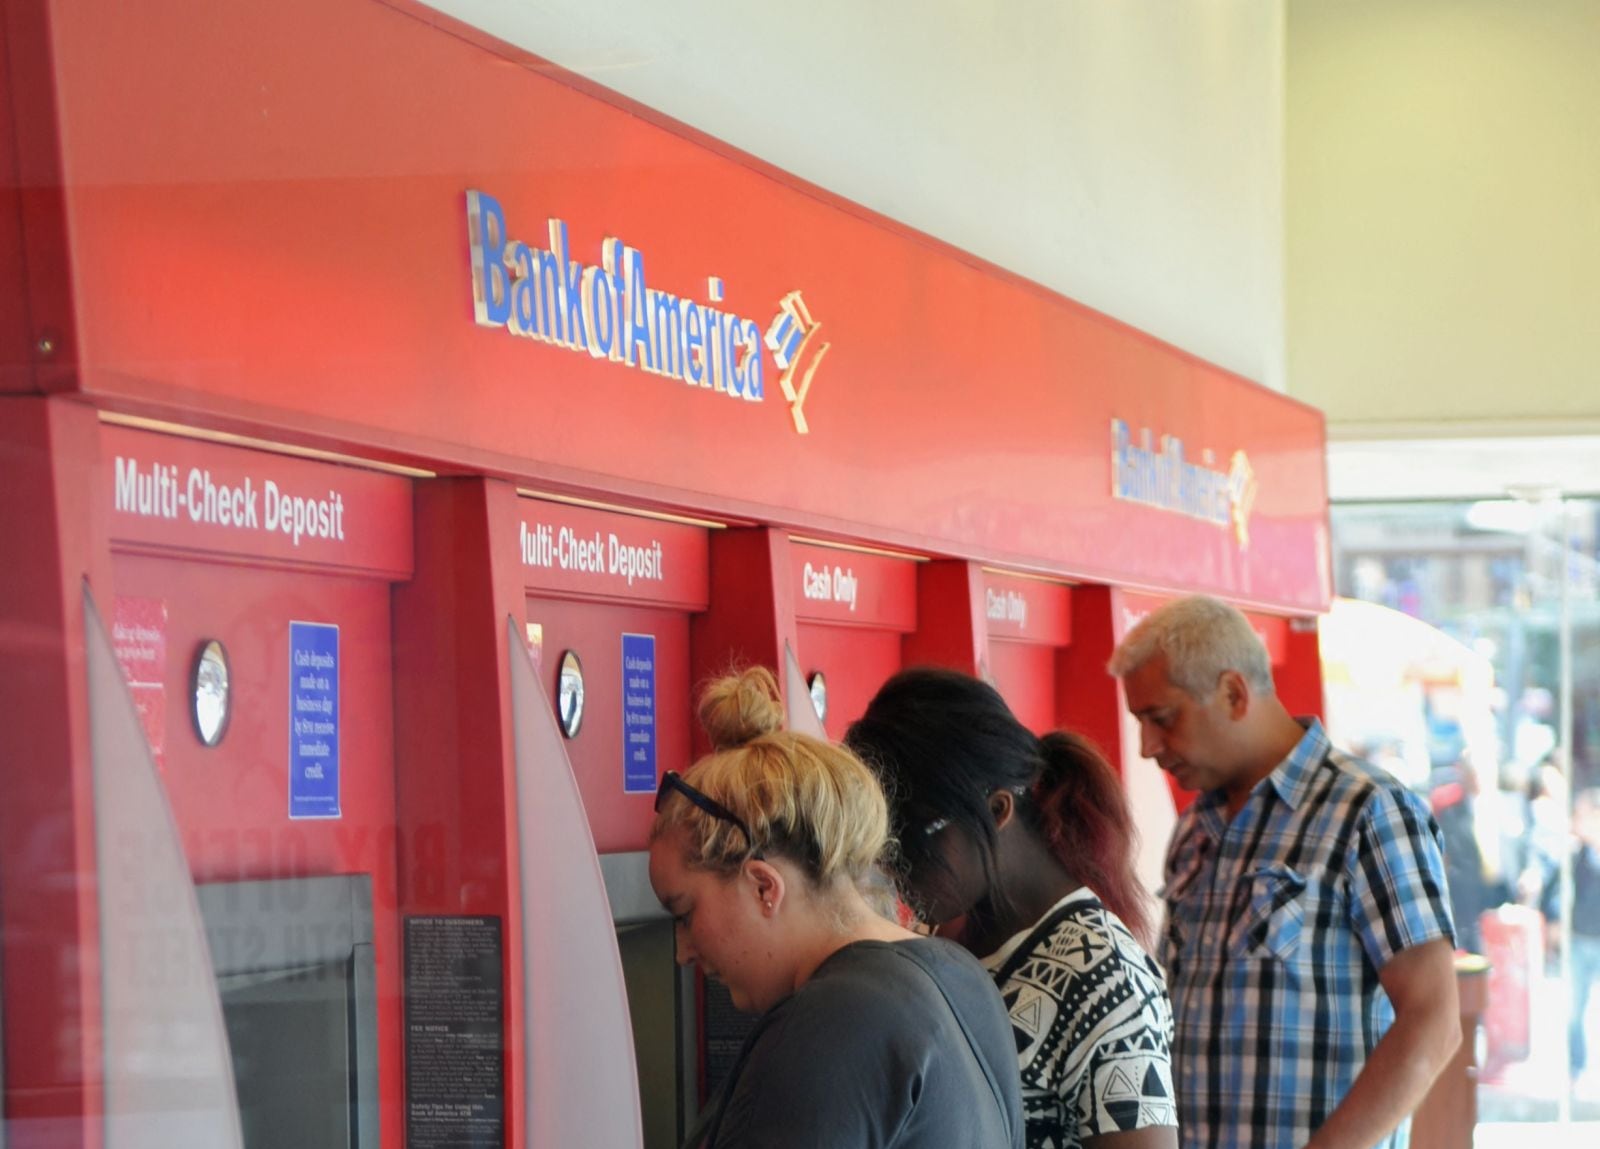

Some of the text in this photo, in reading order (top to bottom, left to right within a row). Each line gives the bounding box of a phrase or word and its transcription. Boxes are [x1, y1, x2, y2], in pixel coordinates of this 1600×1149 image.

[115, 457, 344, 545] Multi-Check Deposit
[609, 533, 663, 586] Deposit
[803, 562, 858, 611] Cash Only
